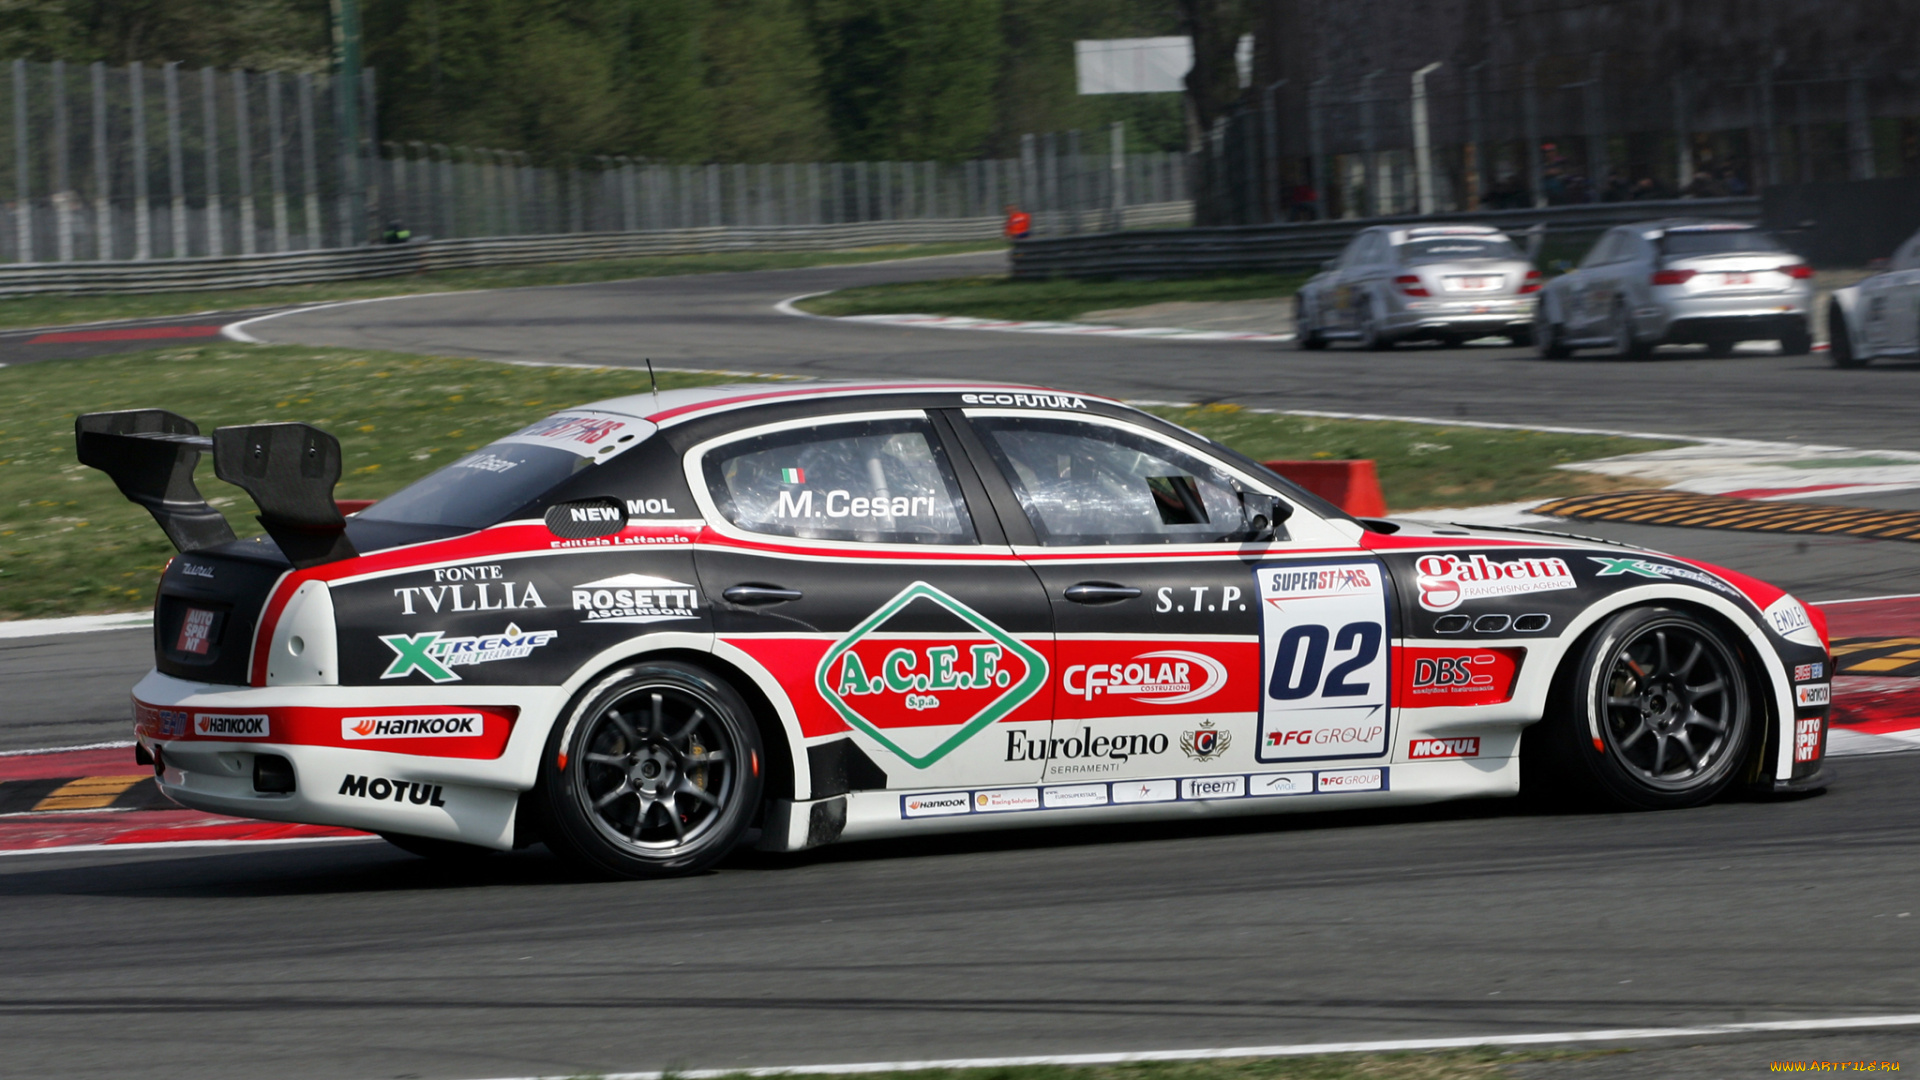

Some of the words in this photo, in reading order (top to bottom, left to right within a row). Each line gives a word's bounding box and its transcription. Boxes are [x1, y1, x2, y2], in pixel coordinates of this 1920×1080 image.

[570, 507, 620, 522] NEW
[626, 499, 676, 514] MOL
[778, 489, 936, 518] M.Cesari
[434, 565, 503, 582] FONTE
[1272, 568, 1371, 592] SUPERSTARS
[1418, 553, 1568, 608] gabetti
[1464, 584, 1530, 596] FRANCHISING
[1533, 579, 1573, 591] AGENCY
[394, 581, 546, 615] TVLLIA
[572, 589, 699, 610] ROSETTI
[188, 609, 214, 626] AUTO
[588, 608, 693, 619] ASCENSORI
[184, 623, 208, 639] SPRI
[185, 638, 200, 651] NT
[838, 644, 1010, 695] A.C.E.F.
[1269, 621, 1382, 700] 02
[1413, 656, 1472, 687] DBS
[1140, 683, 1190, 692] COSTRUZIONI
[1004, 727, 1169, 764] Eurolegno
[1283, 730, 1312, 746] FG
[1315, 726, 1382, 745] GROUP
[1412, 739, 1476, 756] MOTUL
[1050, 763, 1120, 775] SERRAMENTI
[1191, 780, 1236, 796] freem
[1328, 777, 1344, 785] FG
[1345, 775, 1380, 784] GROUP
[338, 774, 446, 807] MOTUL
